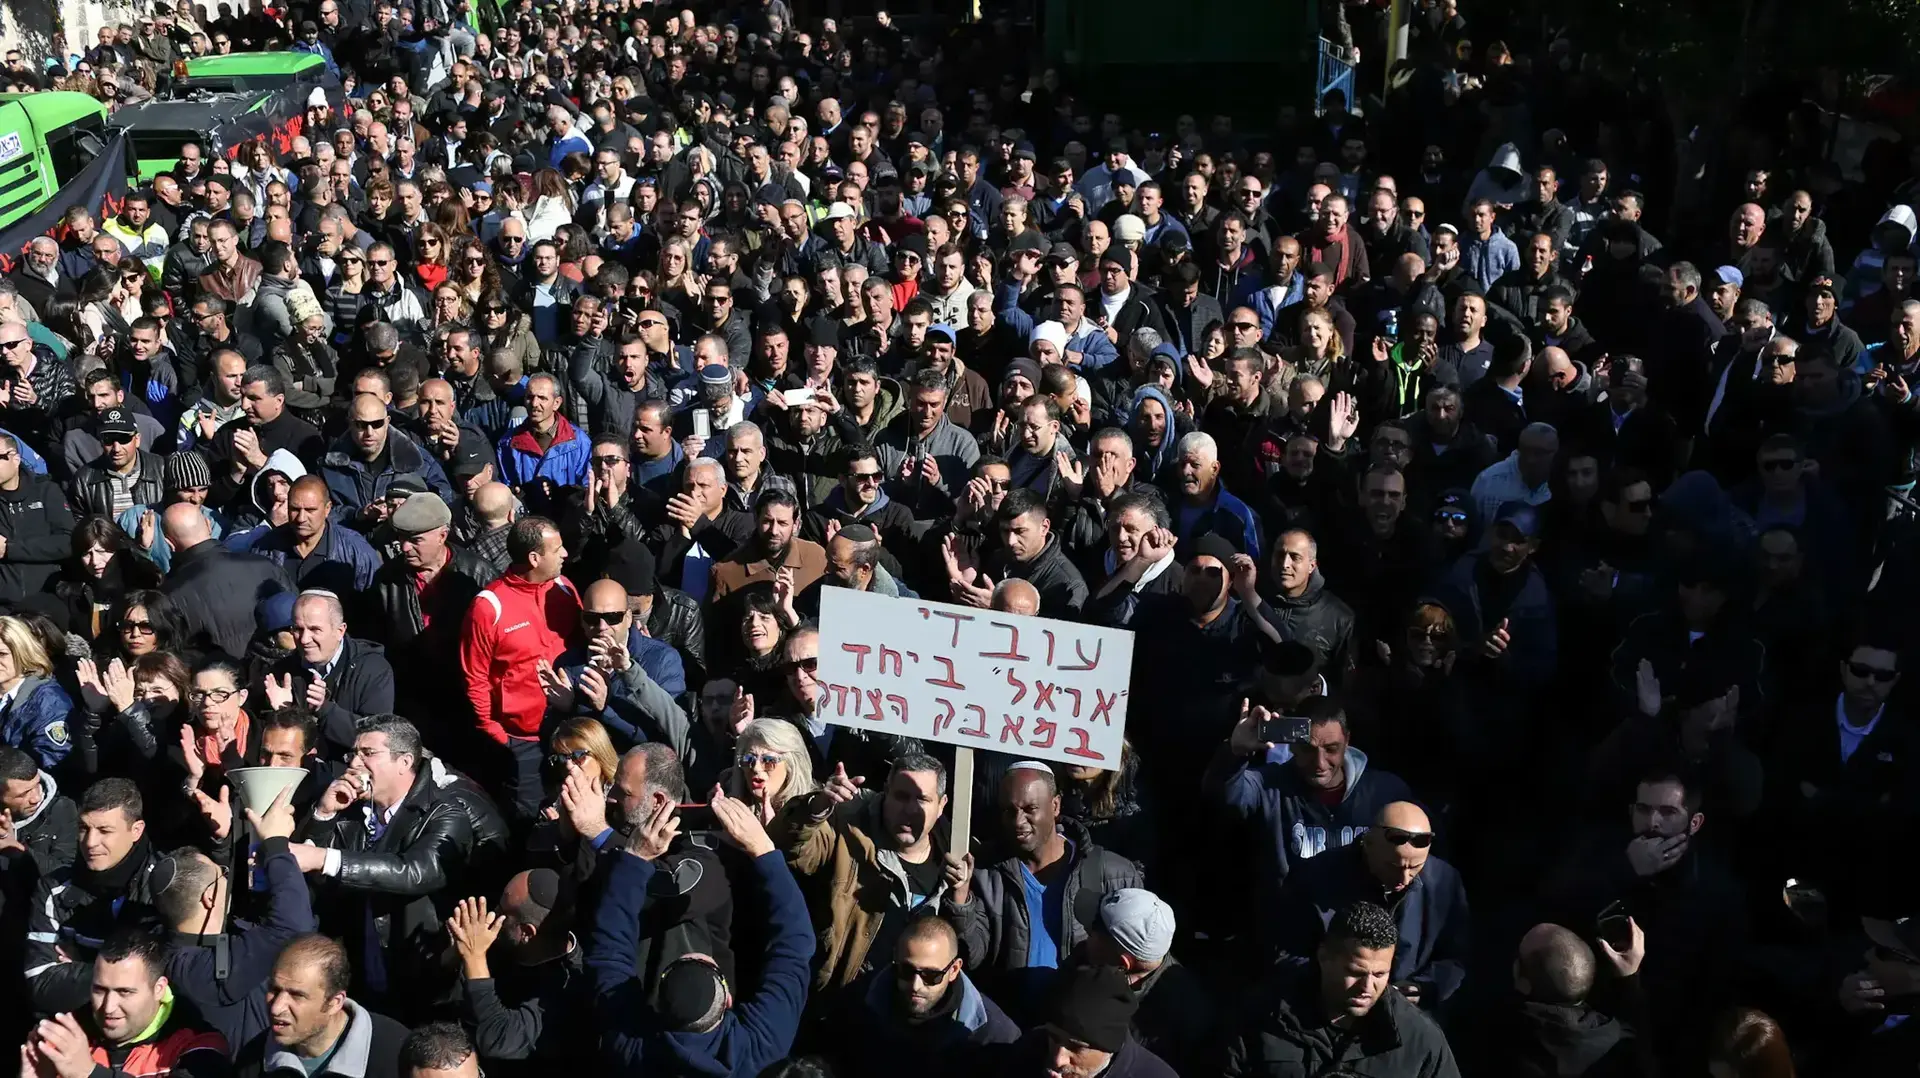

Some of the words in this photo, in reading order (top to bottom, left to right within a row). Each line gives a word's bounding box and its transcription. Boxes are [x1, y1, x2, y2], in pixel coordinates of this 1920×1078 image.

[841, 642, 966, 690] ביחד
[918, 607, 1102, 670] עובדי
[816, 680, 908, 724] הצודק
[933, 697, 1105, 760] במאבק
